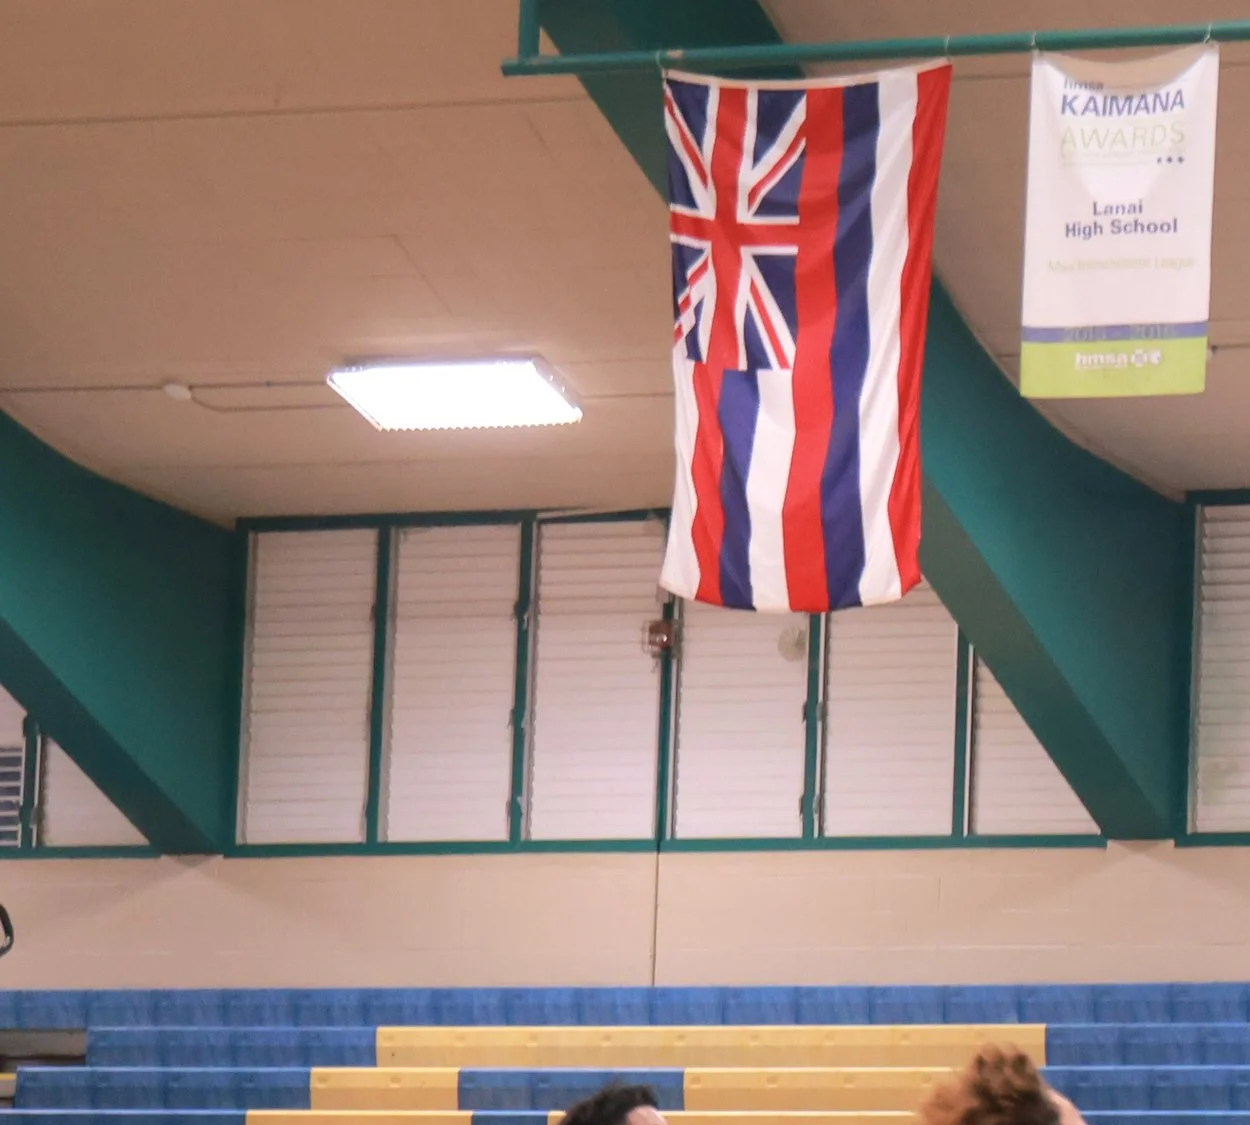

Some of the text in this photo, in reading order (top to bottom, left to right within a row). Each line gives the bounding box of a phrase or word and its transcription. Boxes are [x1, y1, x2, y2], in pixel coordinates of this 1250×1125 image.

[1061, 88, 1185, 117] KAIMANA
[1060, 120, 1185, 149] AWARDS
[1093, 198, 1143, 216] Lanai
[1065, 217, 1178, 240] High School
